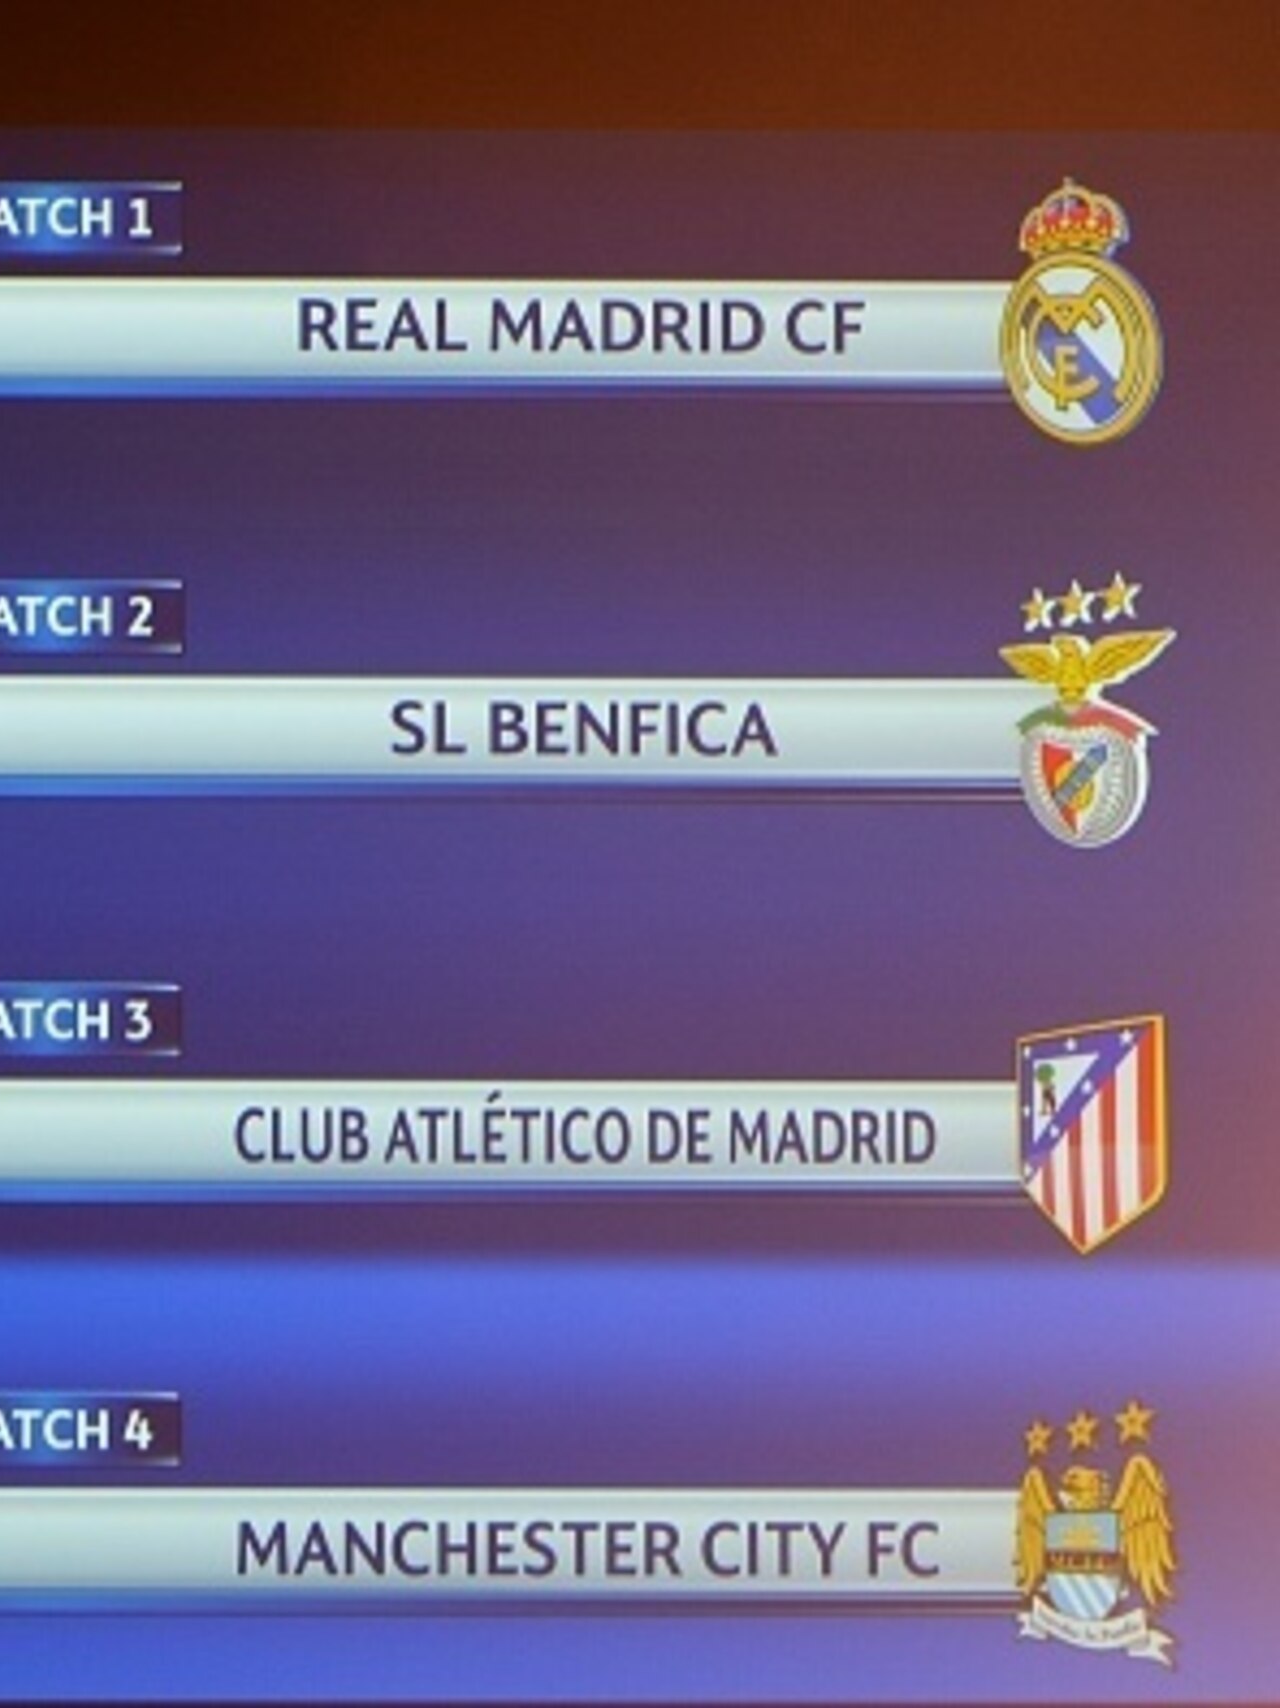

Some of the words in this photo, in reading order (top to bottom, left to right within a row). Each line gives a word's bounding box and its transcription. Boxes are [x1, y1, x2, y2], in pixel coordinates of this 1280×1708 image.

[129, 198, 152, 236] 1
[298, 299, 467, 353] REAL
[491, 300, 764, 353] MADRID
[785, 300, 866, 354] CF
[128, 596, 153, 636] 2
[391, 701, 467, 755] SL
[490, 702, 777, 757] BENFICA
[125, 1000, 152, 1040] 3
[234, 1107, 369, 1164] CLUB
[384, 1091, 631, 1164] ATLÉTICO
[648, 1110, 712, 1164] DE
[730, 1110, 936, 1164] MADRID
[124, 1409, 153, 1450] 4
[236, 1521, 681, 1577] MANCHESTER
[702, 1521, 845, 1577] CITY
[867, 1522, 940, 1577] FC
